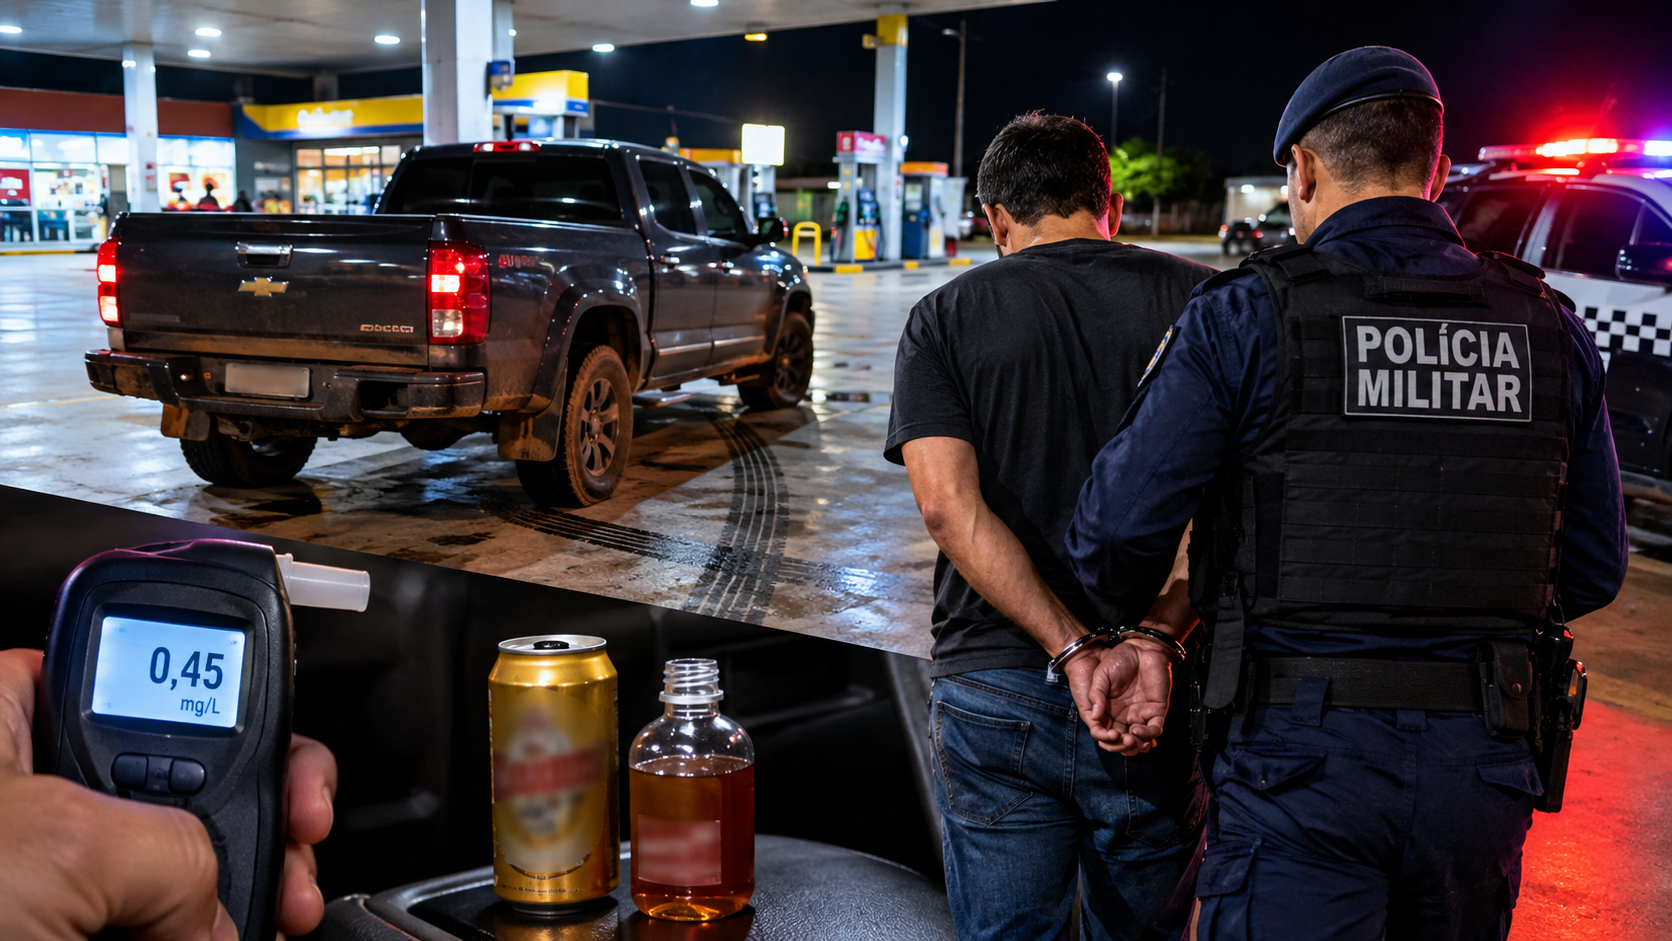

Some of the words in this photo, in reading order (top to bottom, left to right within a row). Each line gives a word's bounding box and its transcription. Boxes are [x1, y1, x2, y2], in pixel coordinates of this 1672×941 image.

[1356, 323, 1520, 368] POLÍCIA
[1357, 368, 1522, 413] MILITAR
[149, 646, 224, 691] 0,45
[180, 697, 220, 717] mg/L
